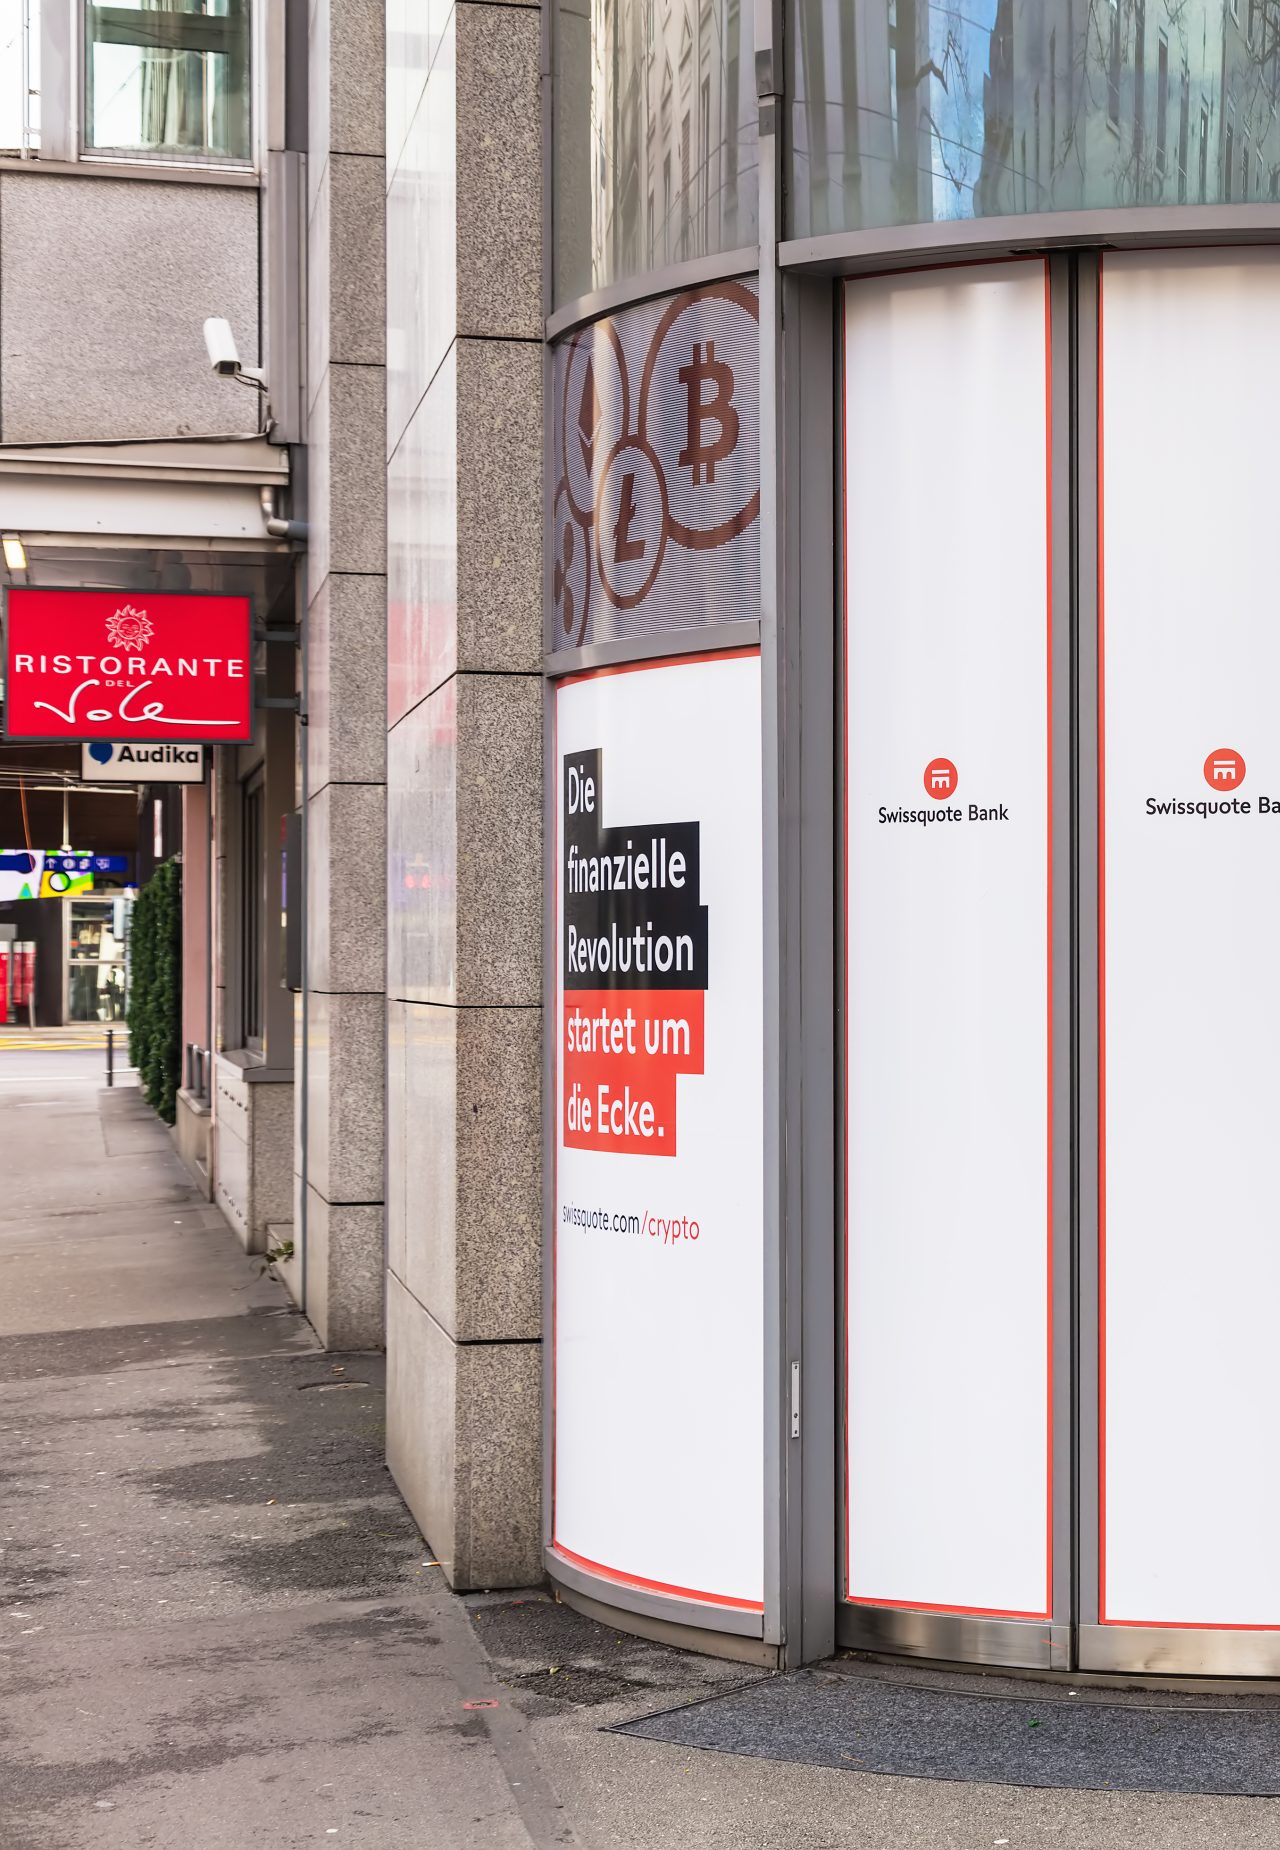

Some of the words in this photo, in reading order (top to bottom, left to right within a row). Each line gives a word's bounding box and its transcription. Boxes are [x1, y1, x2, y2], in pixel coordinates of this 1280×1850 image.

[15, 654, 244, 678] RISTORANTE
[105, 679, 135, 688] DEL
[117, 745, 199, 764] Audika
[568, 765, 595, 815] Die
[1145, 798, 1251, 818] Swissquote
[878, 806, 963, 827] Swissquote
[968, 804, 1009, 822] Bank
[567, 838, 687, 893] finanzielle
[568, 921, 694, 973] Revolution
[567, 1008, 637, 1054] startet
[644, 1018, 690, 1055] um
[567, 1083, 592, 1133] die
[597, 1084, 665, 1137] Ecke.
[562, 1201, 700, 1245] swissquote.com/crypto
